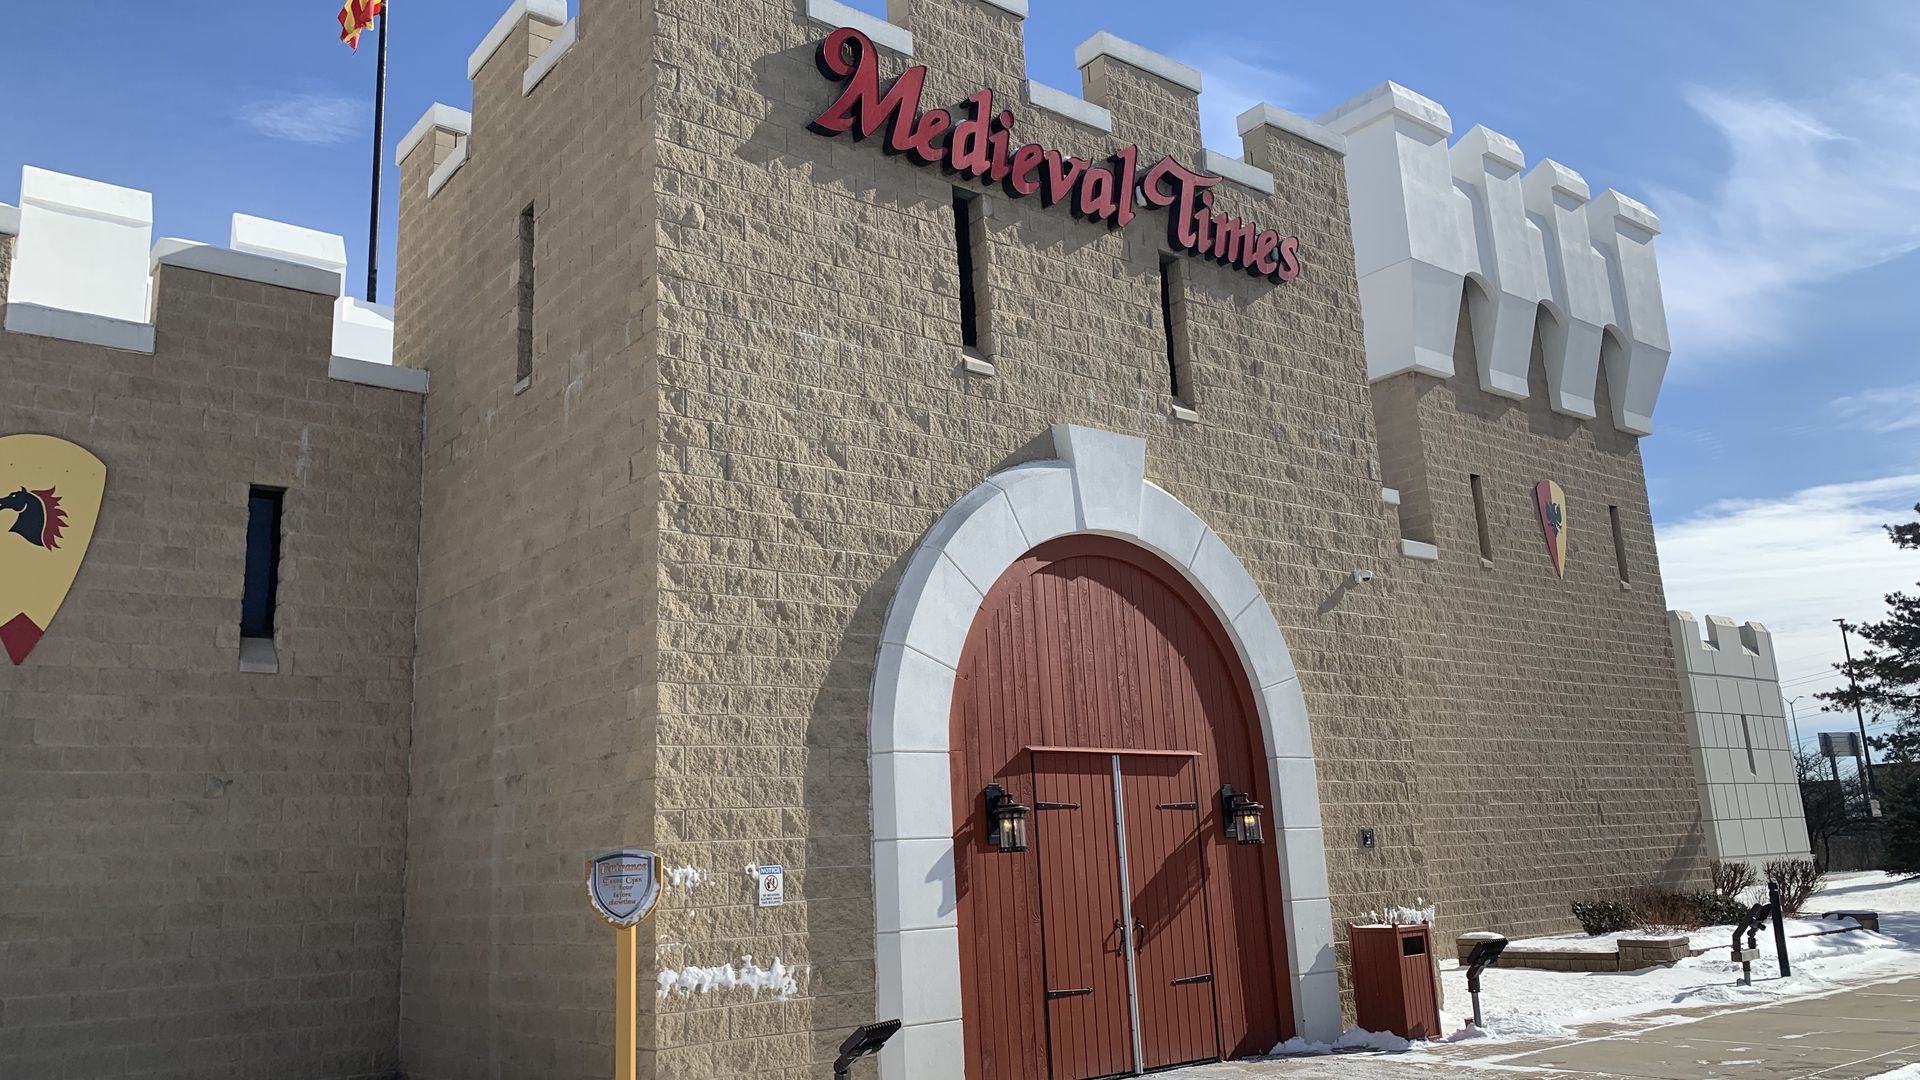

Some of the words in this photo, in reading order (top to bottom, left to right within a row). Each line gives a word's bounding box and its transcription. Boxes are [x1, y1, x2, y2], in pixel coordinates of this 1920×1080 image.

[810, 27, 1137, 227] Medieval
[1141, 154, 1300, 283] Times
[613, 891, 632, 900] before
